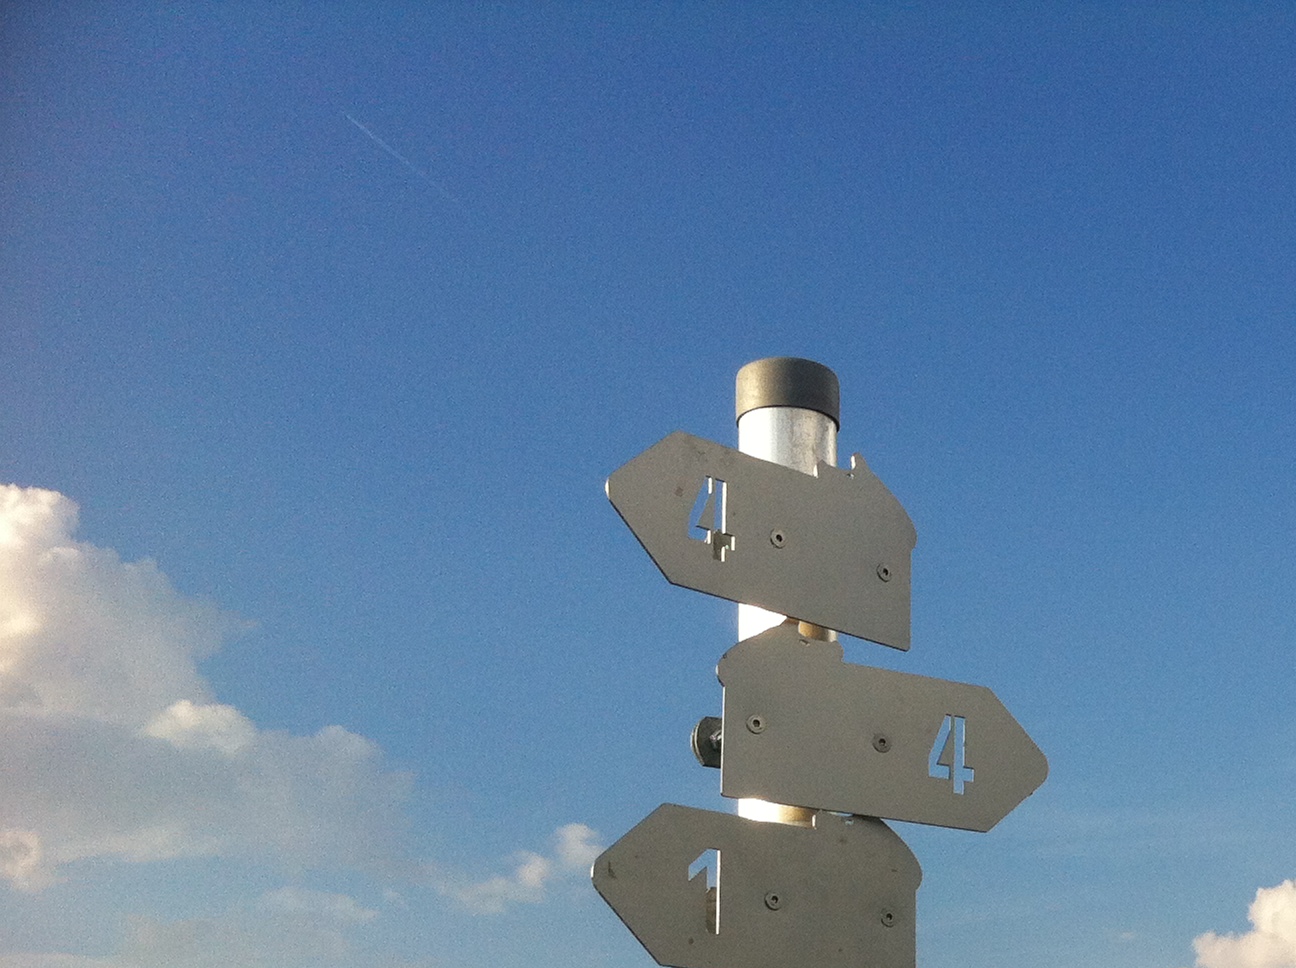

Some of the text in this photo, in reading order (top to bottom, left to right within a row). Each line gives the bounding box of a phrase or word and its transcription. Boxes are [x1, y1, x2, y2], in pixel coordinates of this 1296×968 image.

[688, 475, 735, 562] 4
[928, 713, 974, 795] 4
[688, 848, 721, 935] 1
